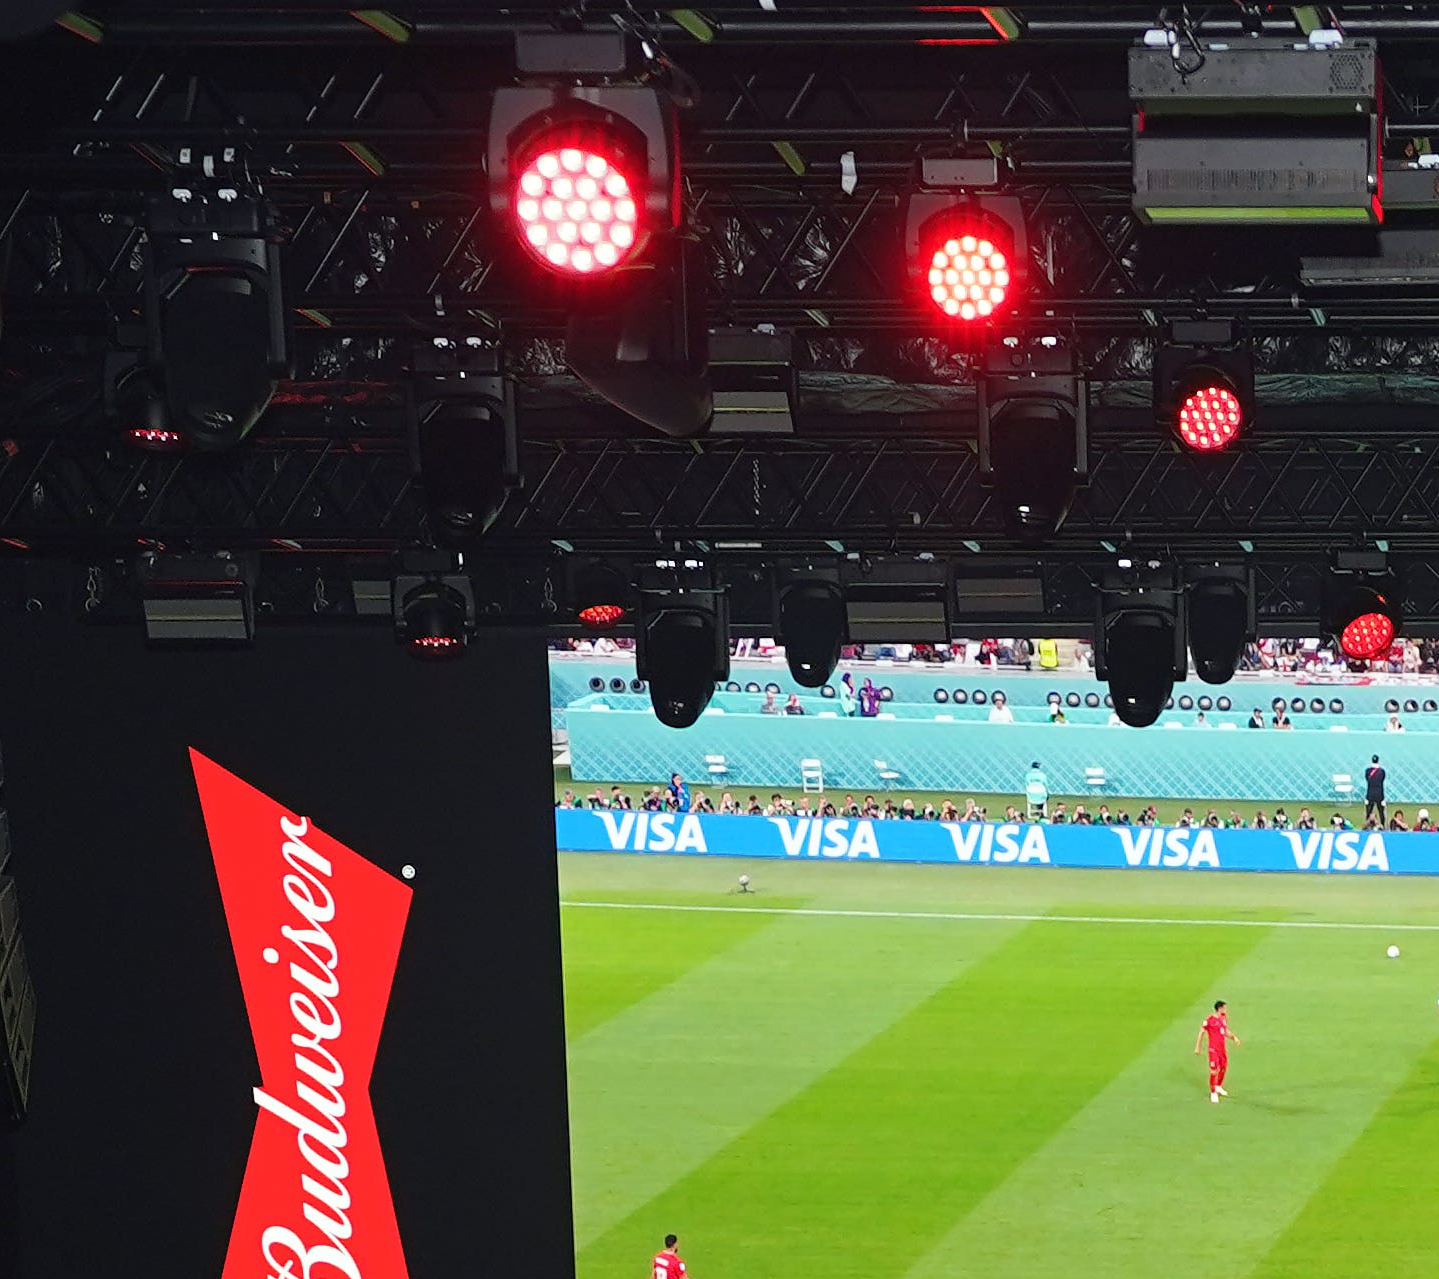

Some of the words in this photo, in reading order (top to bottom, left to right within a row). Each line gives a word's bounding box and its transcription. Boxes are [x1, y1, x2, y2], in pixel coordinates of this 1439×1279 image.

[593, 811, 708, 853] VISA
[768, 817, 880, 859] VISA
[941, 823, 1050, 864] VISA
[1112, 828, 1221, 867] VISA
[1282, 831, 1389, 871] VISA
